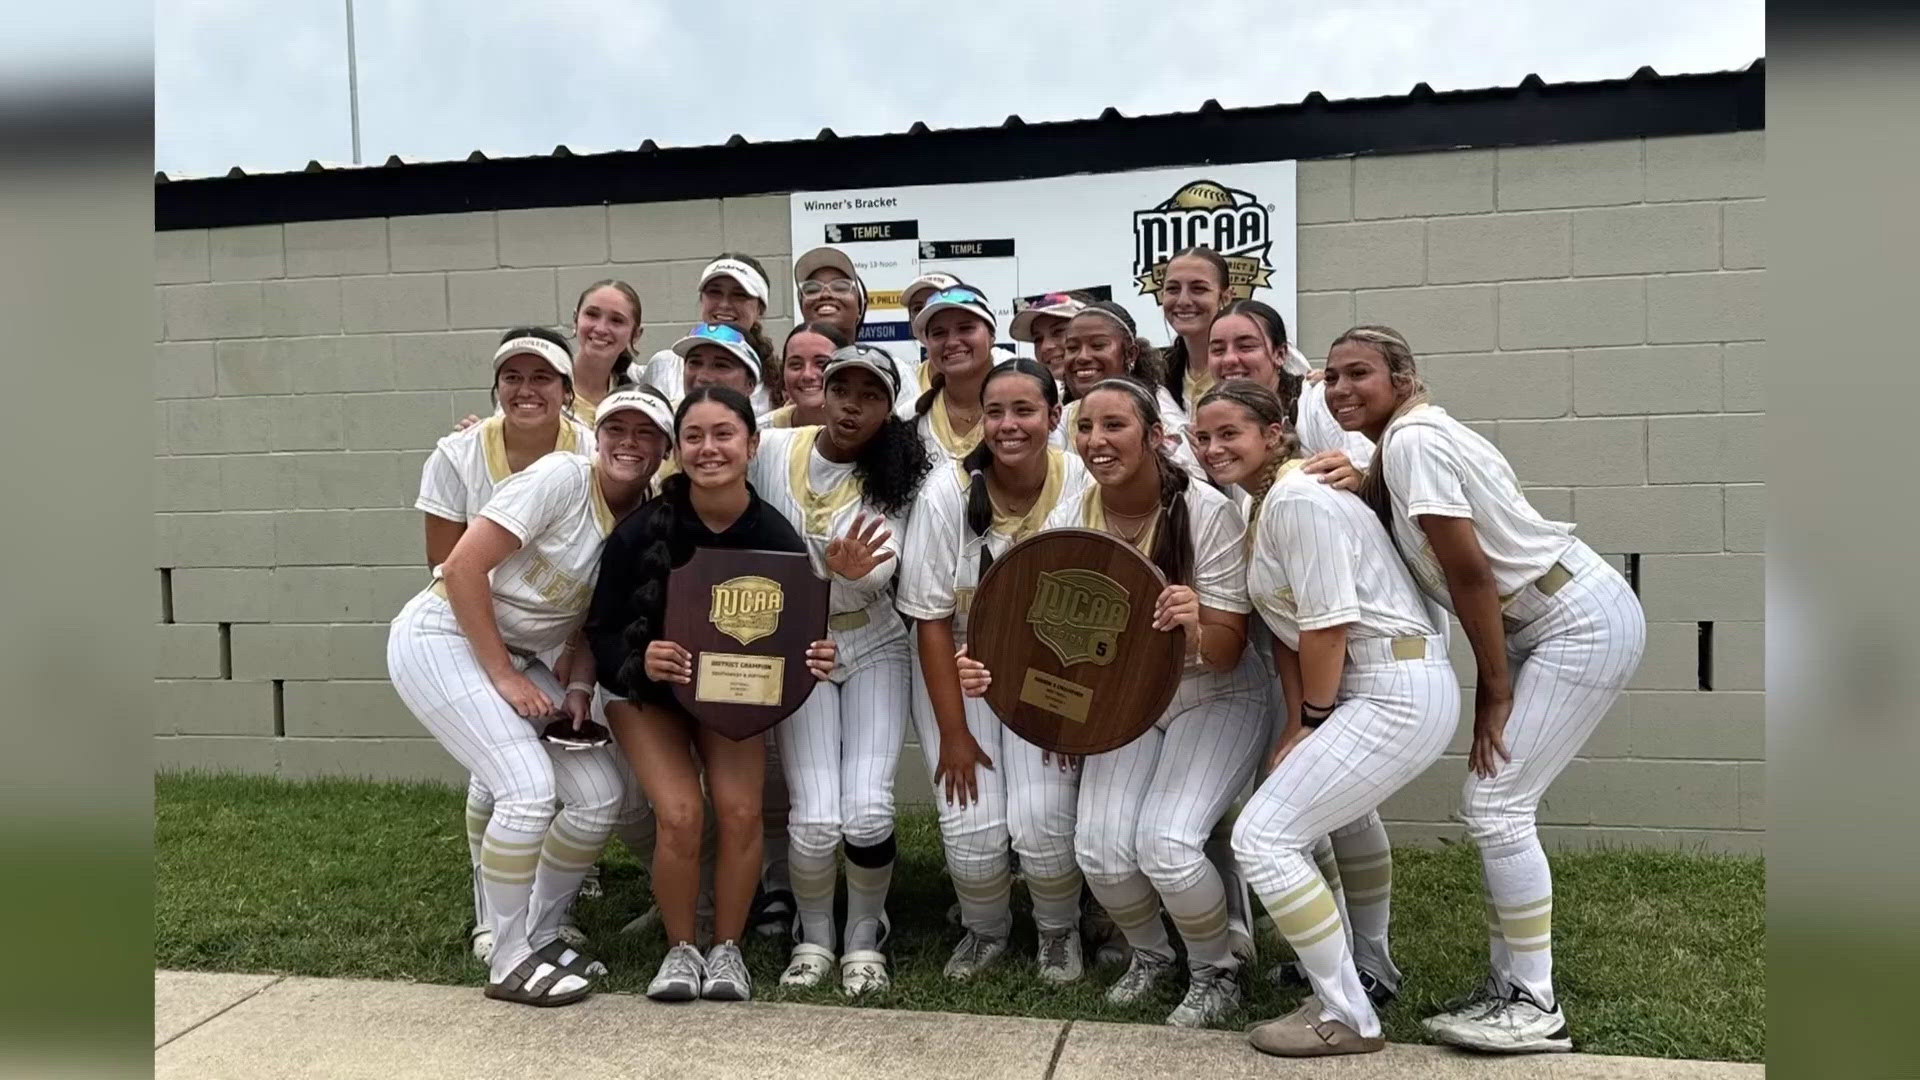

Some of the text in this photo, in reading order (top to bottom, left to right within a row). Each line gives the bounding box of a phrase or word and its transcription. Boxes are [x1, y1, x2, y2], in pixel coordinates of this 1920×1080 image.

[804, 197, 898, 211] Winner's Bracket
[852, 225, 891, 239] TEMPLE
[1141, 210, 1261, 272] NJCAA
[950, 243, 983, 254] TEMPLE
[877, 295, 900, 305] PHILLI
[857, 325, 896, 339] RAYSON
[713, 587, 781, 619] NJCAA
[1031, 577, 1125, 625] NJCAA
[1095, 641, 1108, 657] 5
